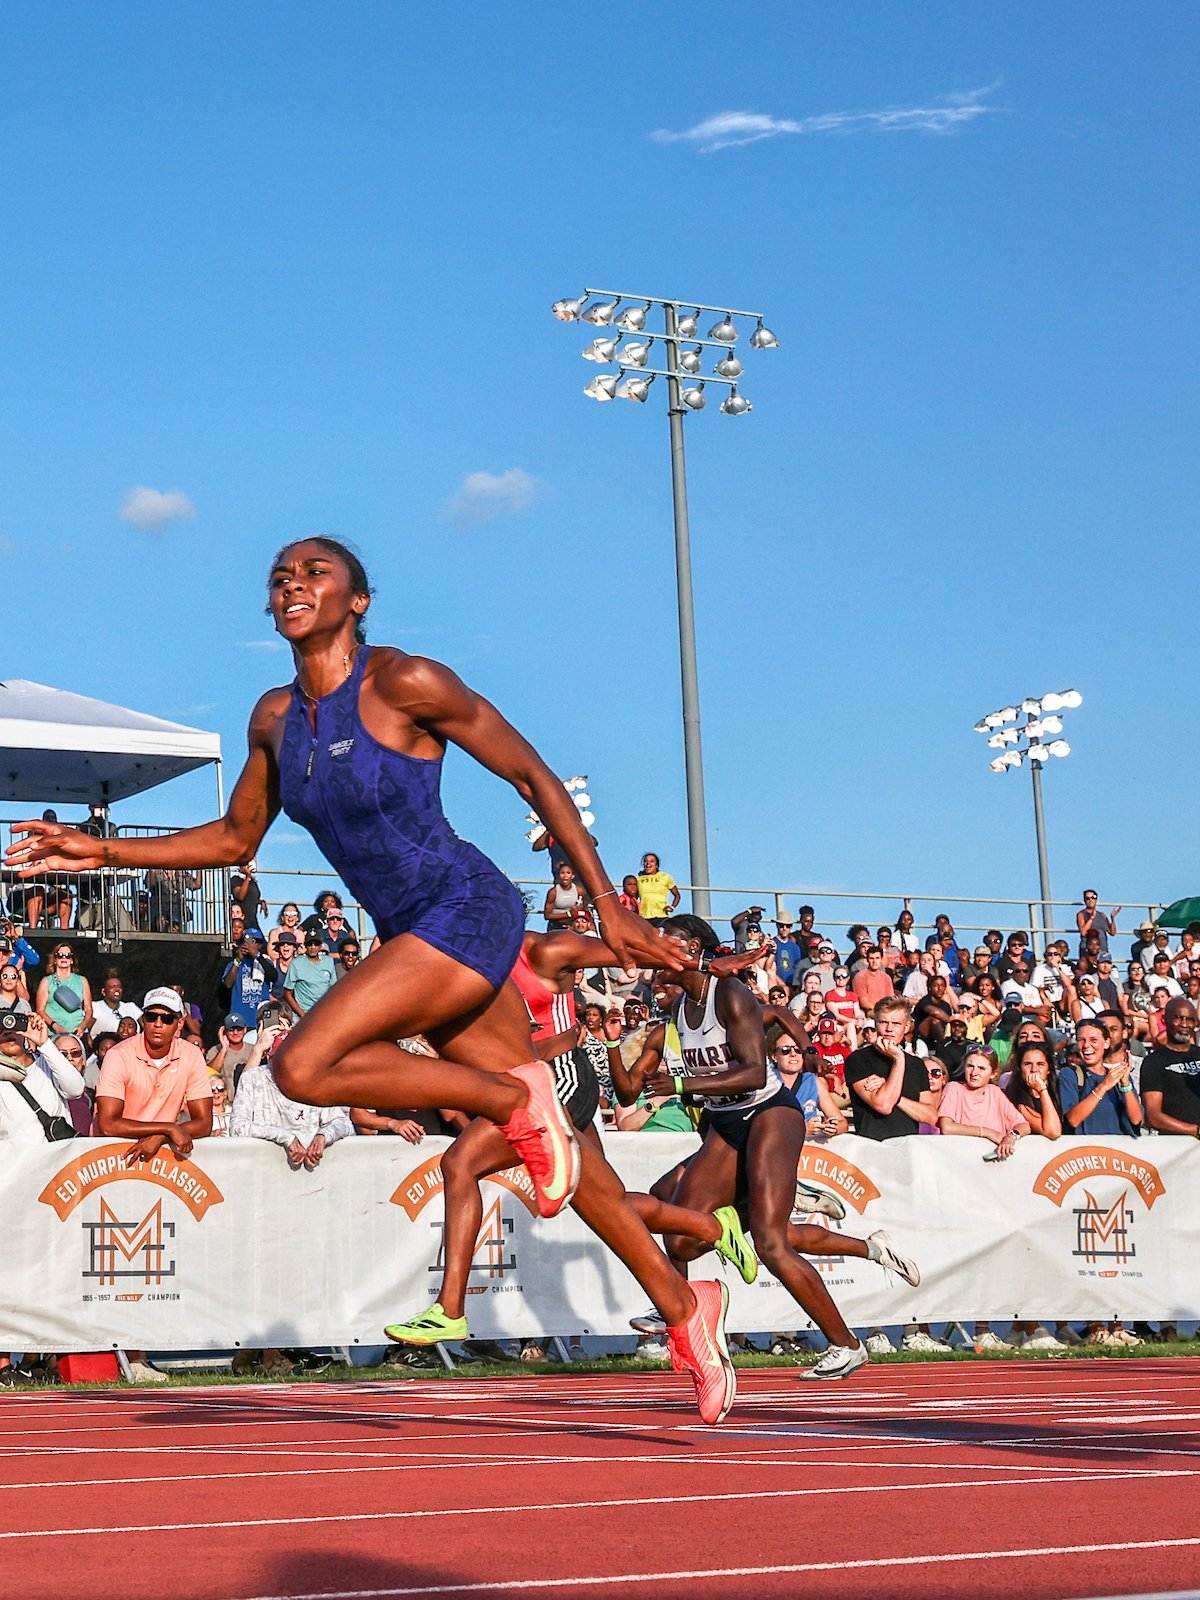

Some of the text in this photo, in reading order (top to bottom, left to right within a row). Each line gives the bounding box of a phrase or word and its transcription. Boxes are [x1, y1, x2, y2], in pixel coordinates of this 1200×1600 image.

[56, 1179, 77, 1203] ED
[151, 1158, 208, 1205] CLASSIC
[815, 1157, 865, 1201] CLASSIC
[1044, 1155, 1156, 1195] ED MURPHEY CLASSIC
[406, 1182, 425, 1205] ED
[147, 1293, 181, 1301] CHAMPION
[491, 1285, 523, 1293] CHAMPION
